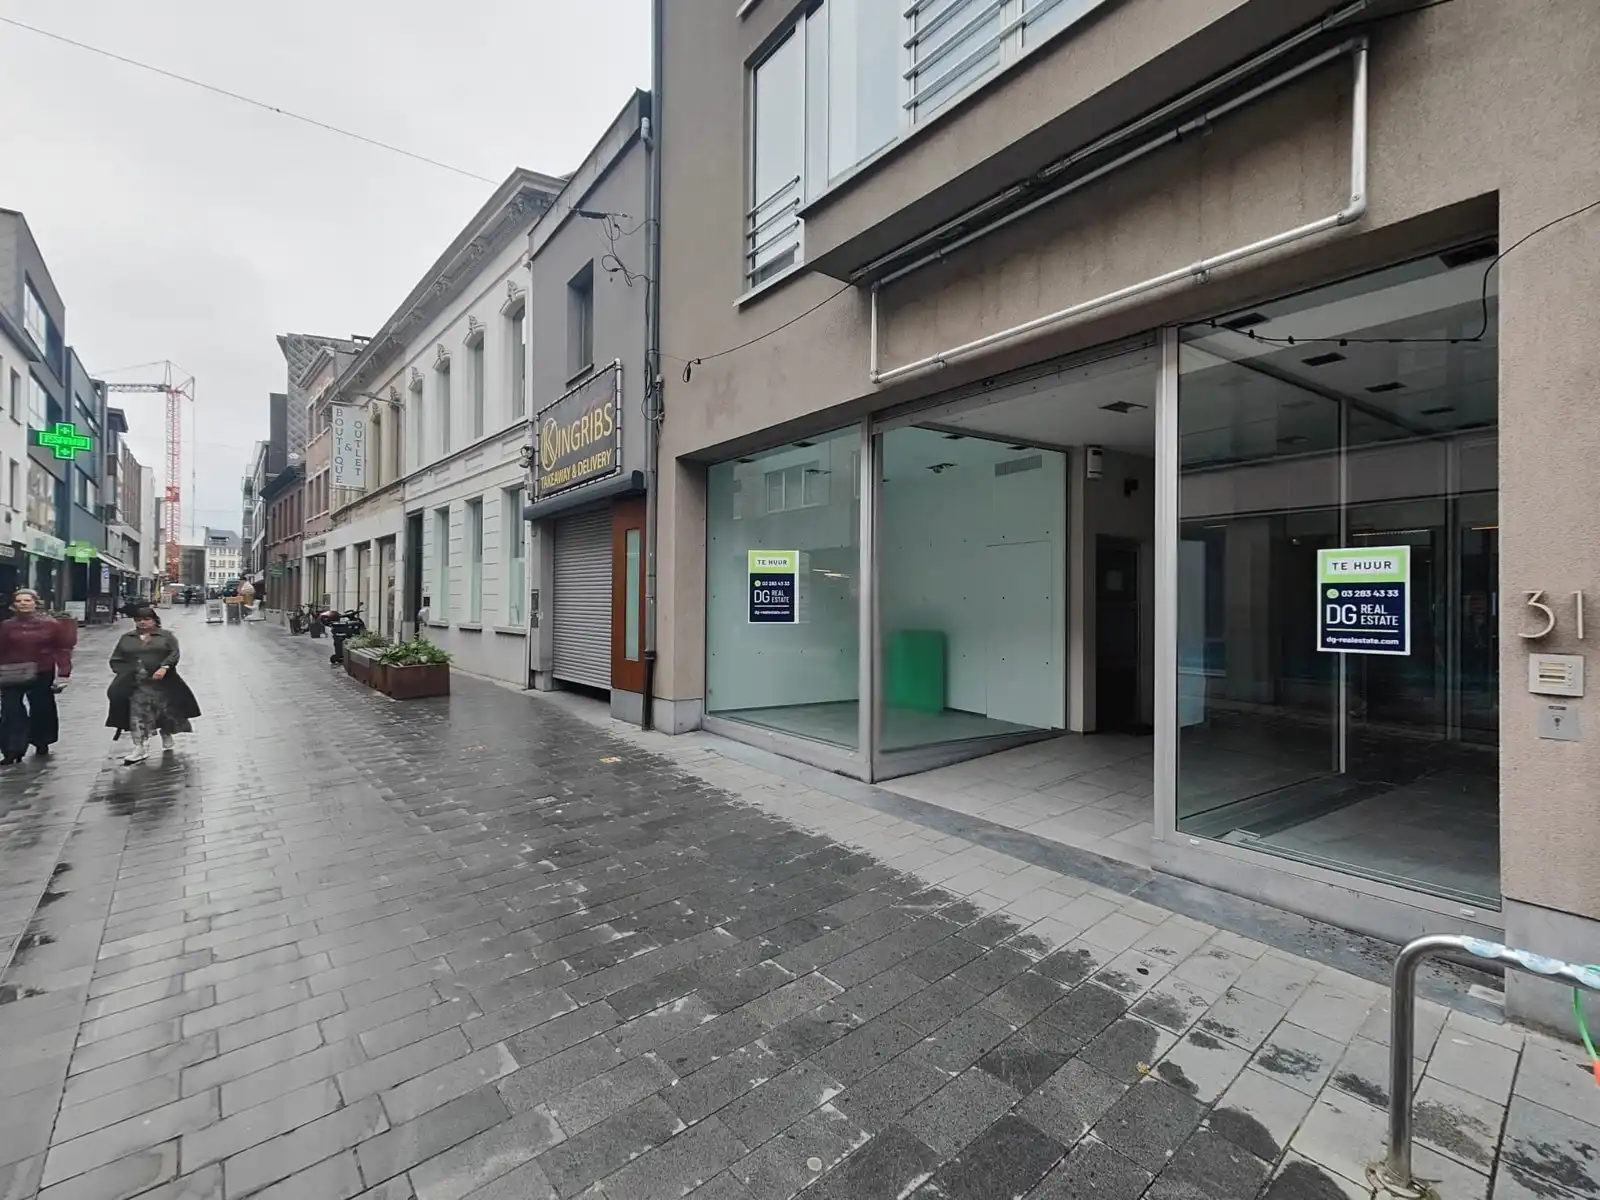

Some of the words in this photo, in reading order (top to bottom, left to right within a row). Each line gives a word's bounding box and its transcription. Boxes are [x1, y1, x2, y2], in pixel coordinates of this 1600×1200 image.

[335, 408, 344, 484] BOUTIQUE
[344, 442, 352, 452] &
[354, 421, 362, 476] OUTLET
[541, 470, 572, 489] TAKEAWAY
[572, 464, 577, 478] &
[578, 448, 612, 475] DELIVERY
[1332, 562, 1348, 571] TE
[1354, 561, 1392, 570] HUUR
[754, 590, 770, 603] DG
[1326, 604, 1357, 625] DG
[1361, 604, 1388, 614] REAL
[1517, 589, 1584, 639] 31
[1361, 615, 1399, 626] ESTATE
[1326, 636, 1399, 645] dg-realestate.com
